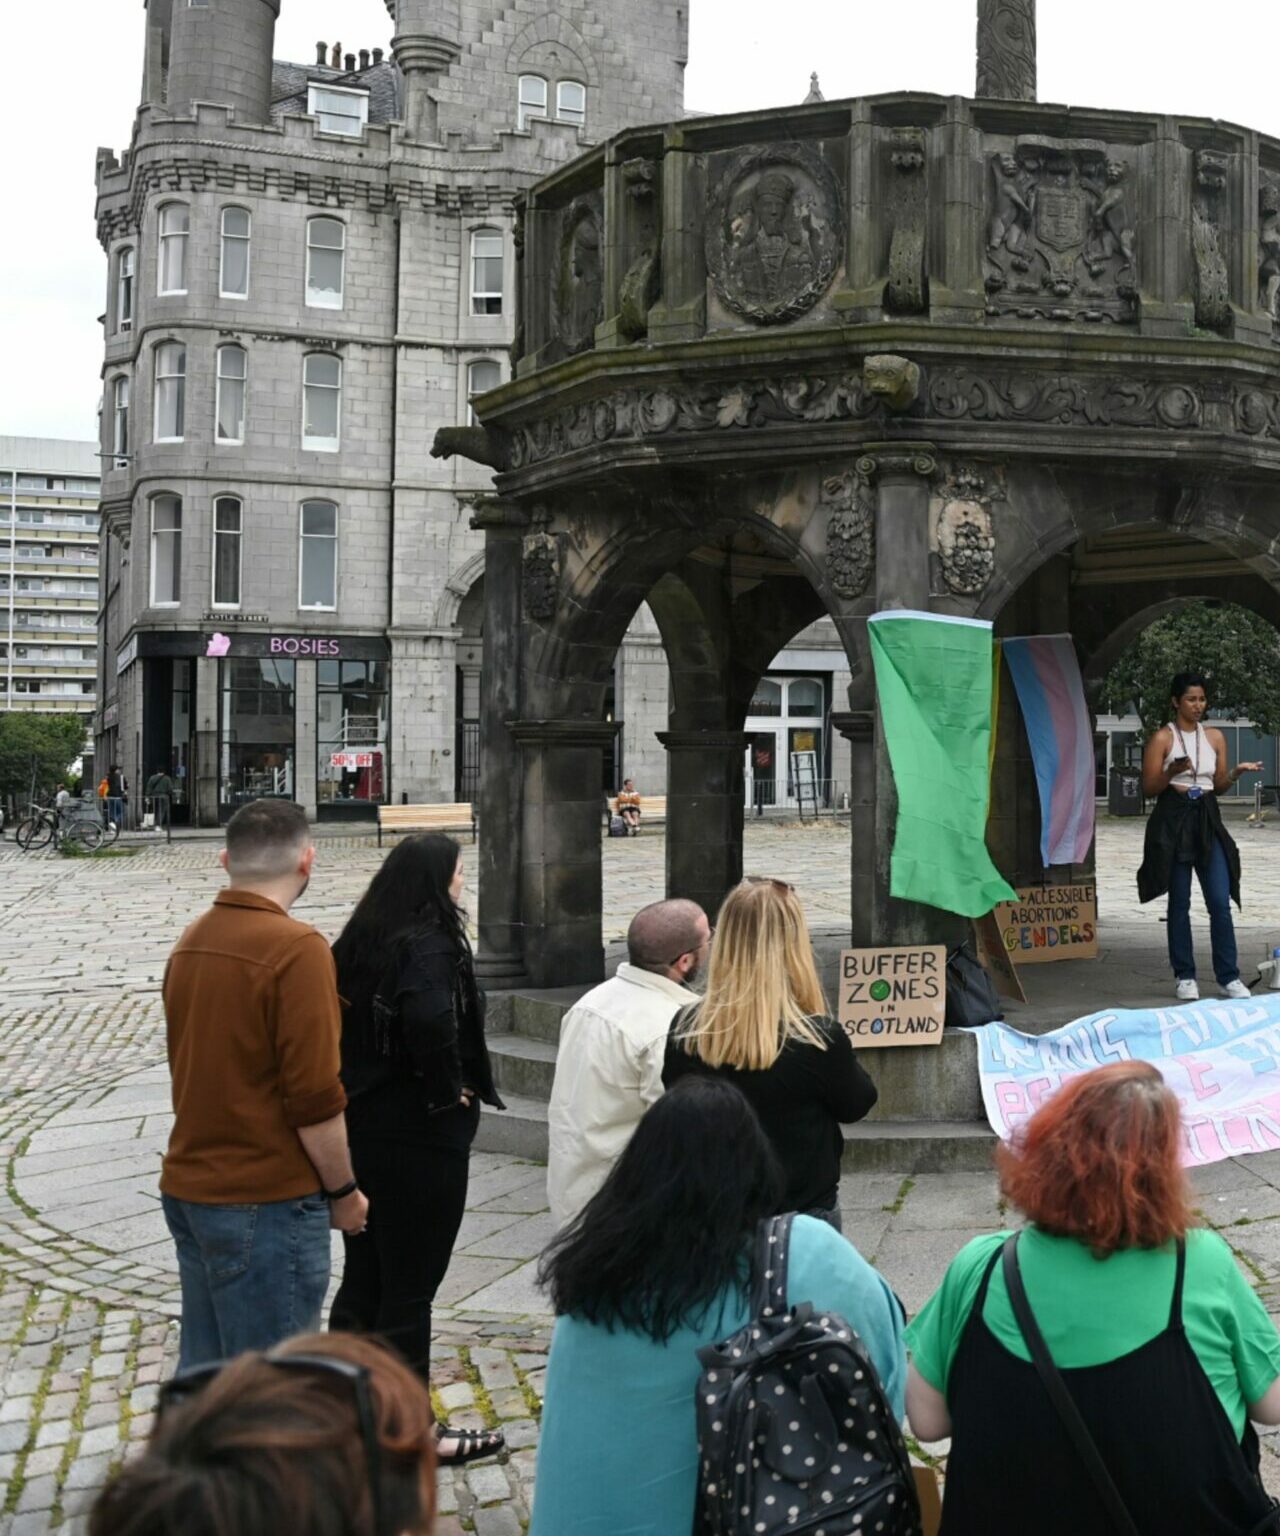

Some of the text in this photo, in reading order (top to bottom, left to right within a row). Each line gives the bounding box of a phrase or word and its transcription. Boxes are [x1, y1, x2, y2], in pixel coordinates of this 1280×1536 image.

[270, 637, 340, 655] BOSIES
[1027, 887, 1092, 905] ACCESSIBLE
[1011, 905, 1079, 925] ABORTIONS
[1003, 922, 1094, 951] GENDERS
[844, 952, 937, 979] BUFFER
[846, 976, 939, 1004] ZONES
[881, 1004, 895, 1013] IN
[844, 1016, 939, 1035] SCOTLAND
